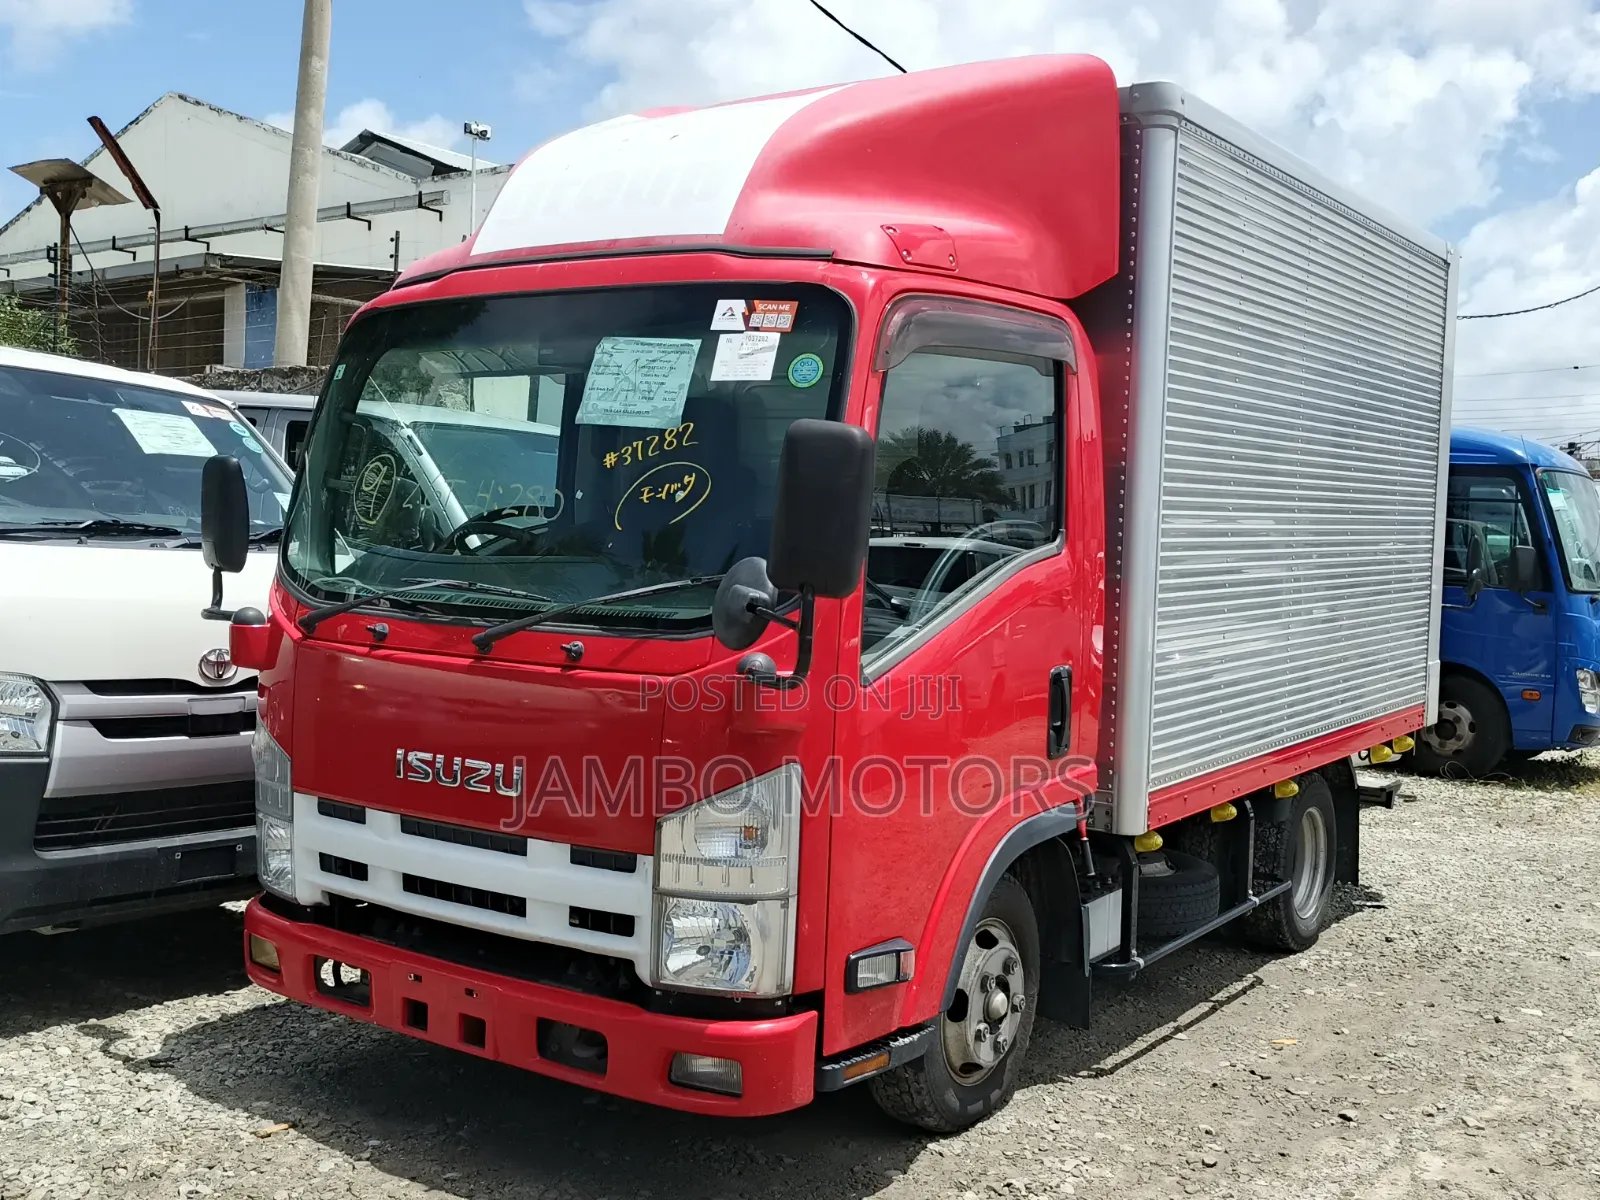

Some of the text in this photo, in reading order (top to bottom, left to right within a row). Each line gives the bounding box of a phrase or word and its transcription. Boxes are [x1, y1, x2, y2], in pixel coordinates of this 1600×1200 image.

[758, 303, 778, 311] SCAN
[602, 422, 699, 469] #37282
[395, 748, 523, 797] ISUZU
